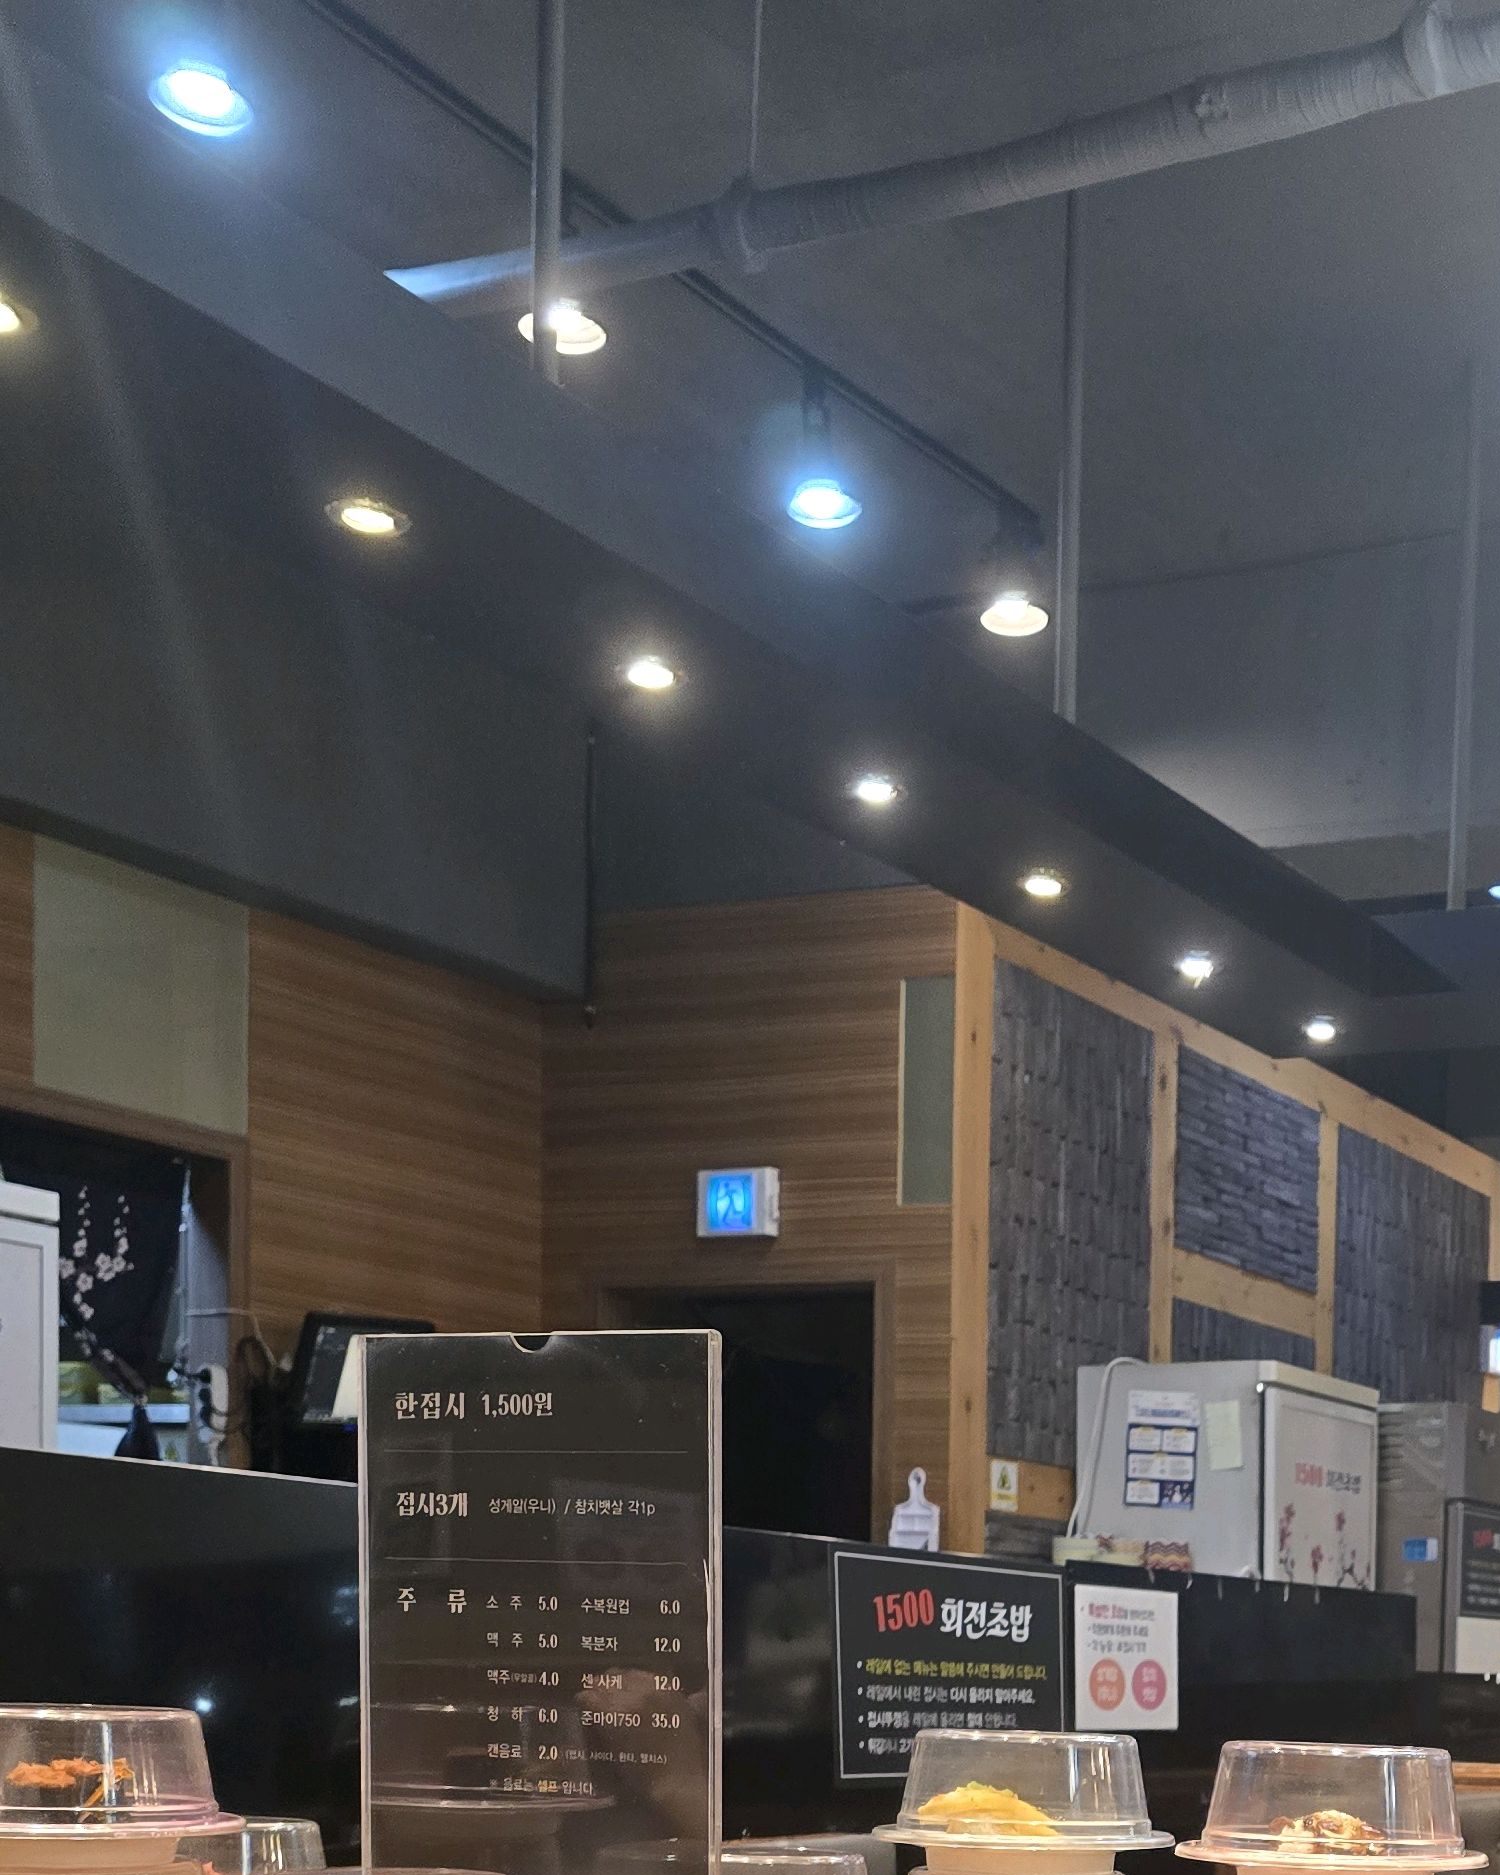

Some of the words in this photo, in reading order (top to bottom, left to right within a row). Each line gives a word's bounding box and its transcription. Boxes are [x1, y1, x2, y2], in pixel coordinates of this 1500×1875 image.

[395, 1392, 466, 1420] 한접시
[482, 1392, 554, 1418] 1,500원
[396, 1492, 468, 1517] 접시3개
[628, 1500, 656, 1518] 각1p
[538, 1596, 558, 1612] 5.0
[581, 1598, 630, 1614] 수복원컵
[660, 1600, 681, 1615] 6.0
[873, 1588, 935, 1634] 1500
[940, 1597, 1033, 1643] 회전초밥
[538, 1633, 558, 1649] 5.0
[581, 1636, 618, 1651] 복분자
[654, 1638, 681, 1652] 12.0
[538, 1671, 559, 1686] 4.0
[654, 1676, 681, 1691] 12.0
[538, 1708, 558, 1723] 6.0
[581, 1711, 641, 1727] 준마이750
[651, 1713, 680, 1728] 35.0
[487, 1743, 522, 1759] 캔음료
[538, 1745, 558, 1760] 2.0
